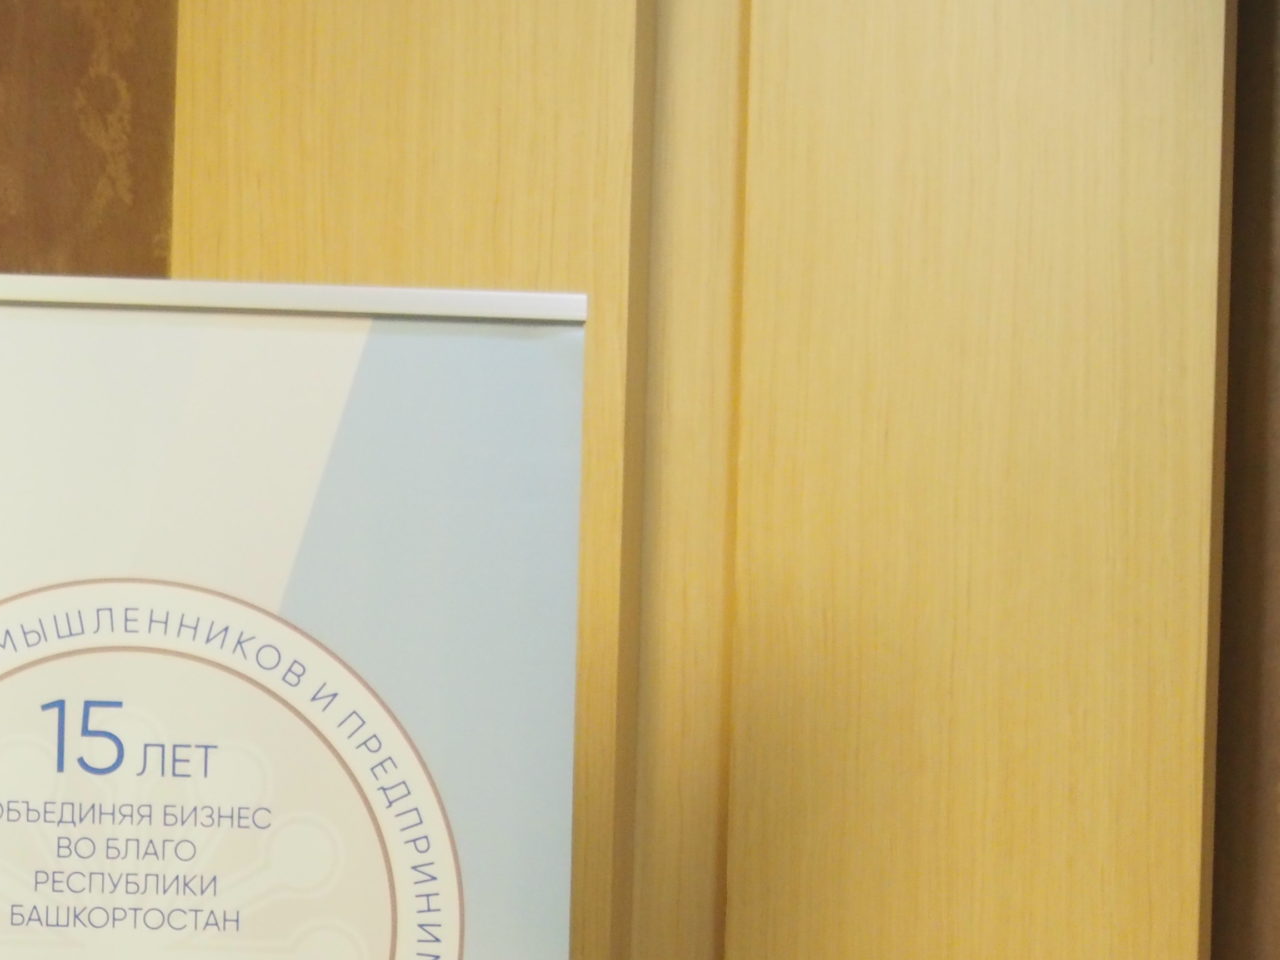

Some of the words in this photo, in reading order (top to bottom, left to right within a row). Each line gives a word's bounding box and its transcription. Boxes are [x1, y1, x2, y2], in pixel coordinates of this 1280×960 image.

[309, 681, 340, 712] И
[40, 698, 125, 776] 15
[135, 743, 219, 778] ЛЕТ
[162, 804, 273, 830] БИЗНЕС
[56, 835, 97, 860] ВО
[105, 837, 197, 862] БЛАГО
[33, 870, 218, 898] РЕСПУБЛИКИ
[9, 904, 241, 932] БАШКОРТОСТАН
